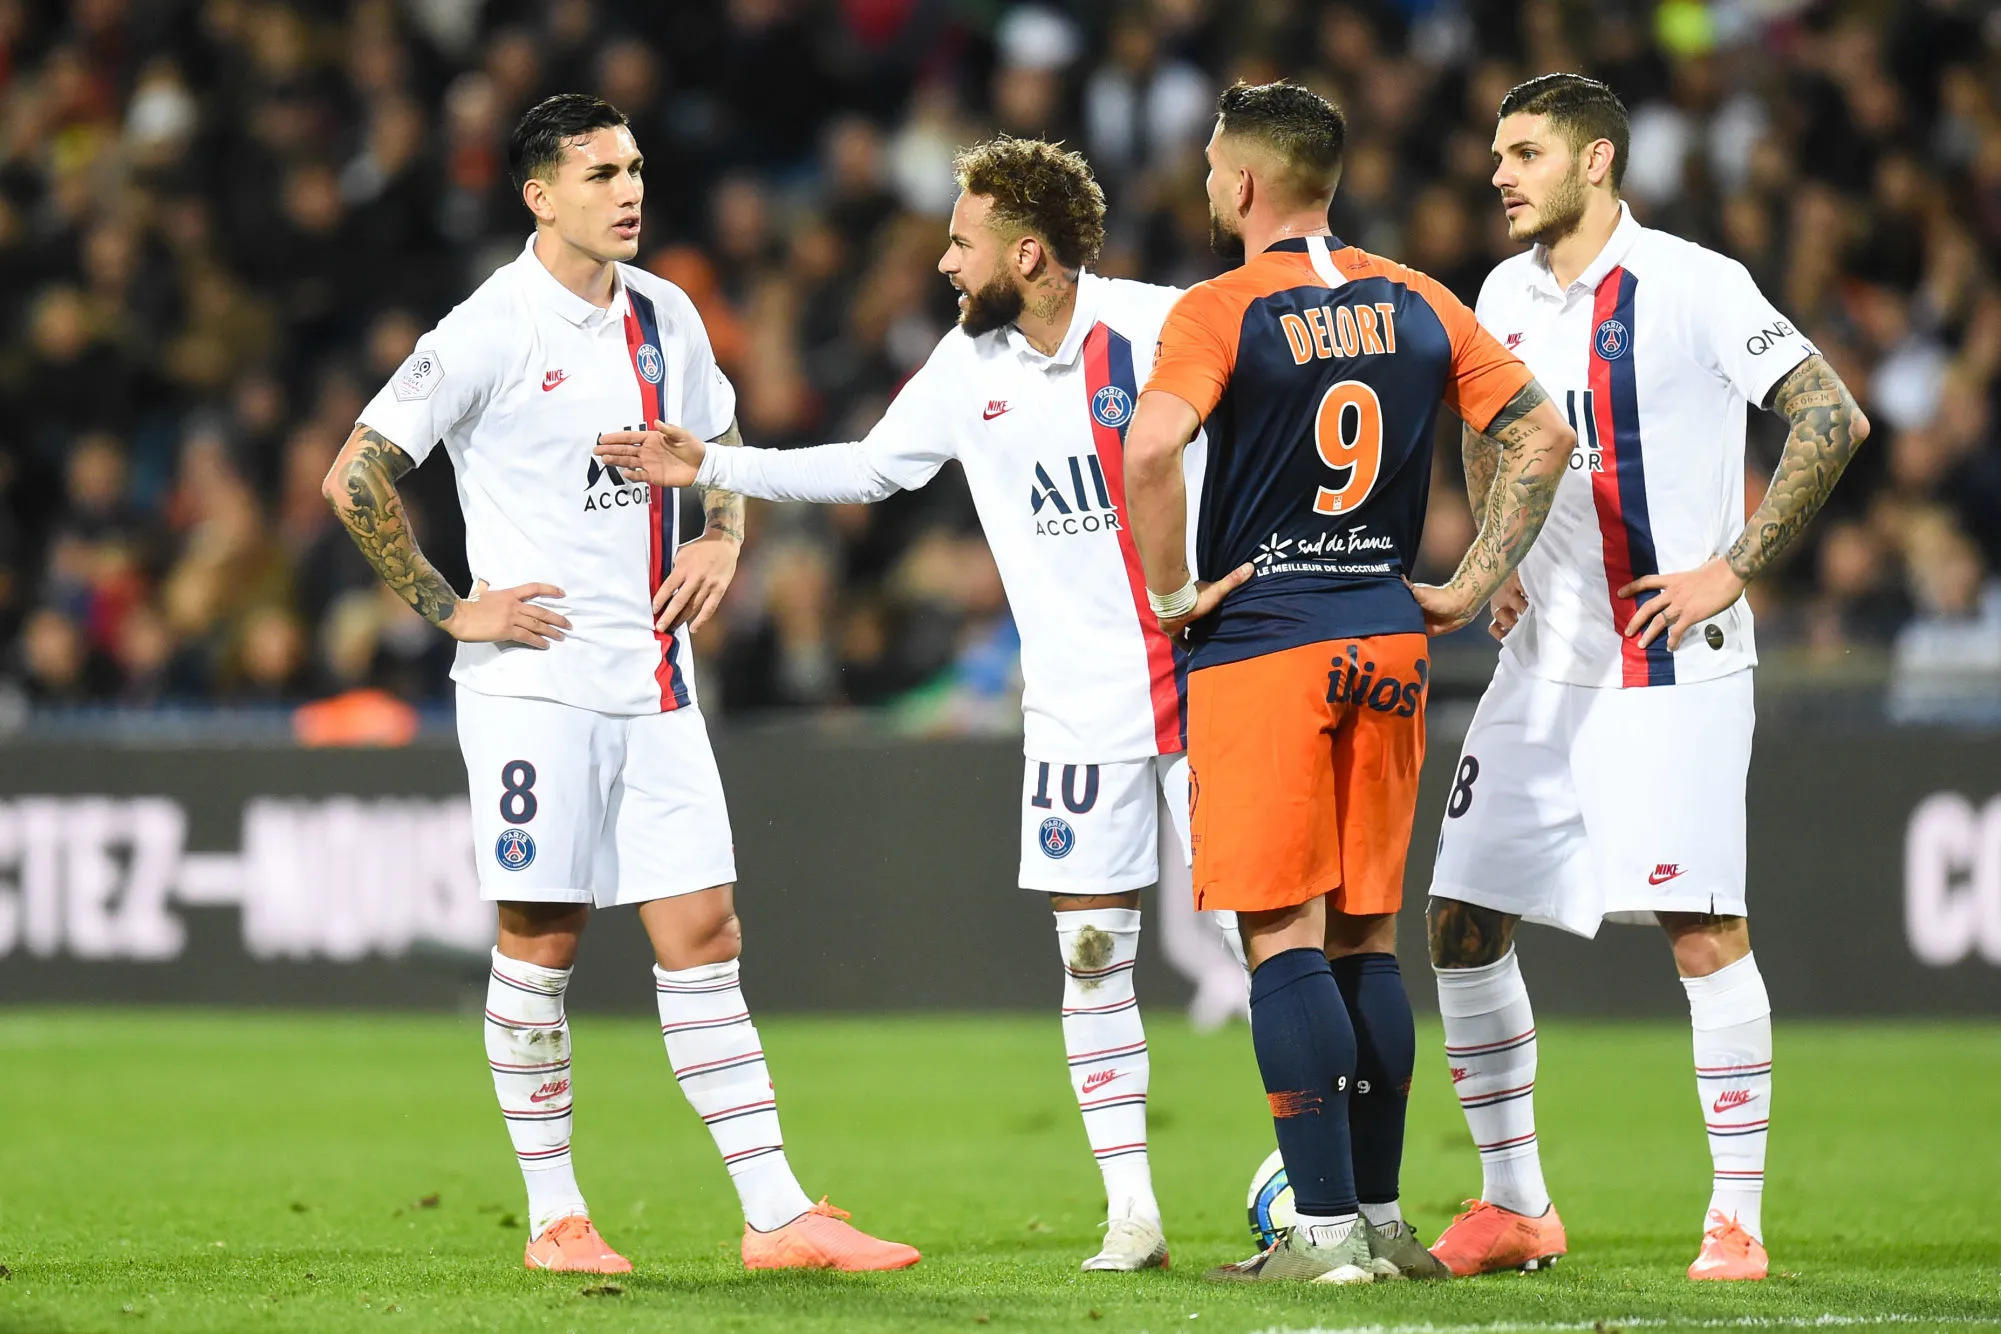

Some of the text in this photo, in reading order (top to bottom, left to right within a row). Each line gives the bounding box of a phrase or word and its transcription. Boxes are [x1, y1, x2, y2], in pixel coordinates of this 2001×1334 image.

[1279, 303, 1396, 366] DELORT
[1601, 322, 1623, 333] PARIS
[1746, 321, 1794, 356] QNB
[545, 369, 563, 382] NIKE
[1097, 387, 1124, 400] PARIS
[987, 399, 1008, 411] NIKE
[1313, 380, 1383, 516] 9
[1036, 513, 1120, 536] ACCOR
[1325, 534, 1346, 552] de
[1348, 525, 1394, 555] France
[1256, 563, 1391, 577] LE MEILLEUR DE L'OCCITANIE
[499, 759, 538, 825] 8
[1031, 761, 1100, 815] 10
[1043, 820, 1067, 831] PARIS
[502, 831, 528, 843] PARIS
[1654, 863, 1680, 875] NIKE
[1086, 1068, 1117, 1084] NIKE
[1338, 1075, 1347, 1092] 9
[538, 1078, 569, 1093] NIKE
[1357, 1079, 1371, 1094] 9
[1718, 1089, 1751, 1102] NIKE
